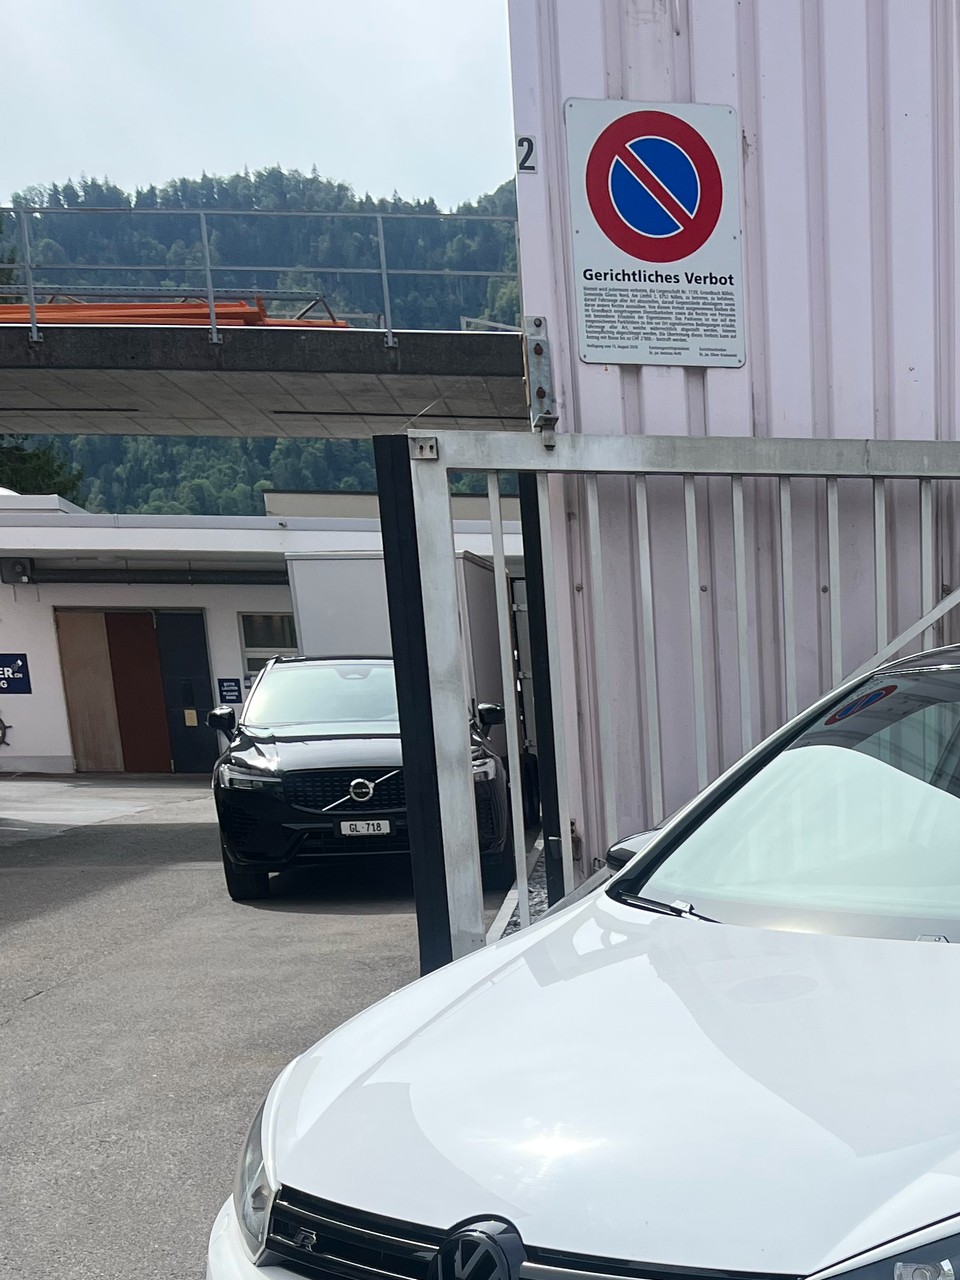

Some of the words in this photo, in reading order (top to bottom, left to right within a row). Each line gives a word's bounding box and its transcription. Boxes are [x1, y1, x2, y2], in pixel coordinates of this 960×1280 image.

[518, 137, 535, 170] 2
[583, 268, 680, 284] Gerichtliches
[684, 272, 735, 286] Verbot
